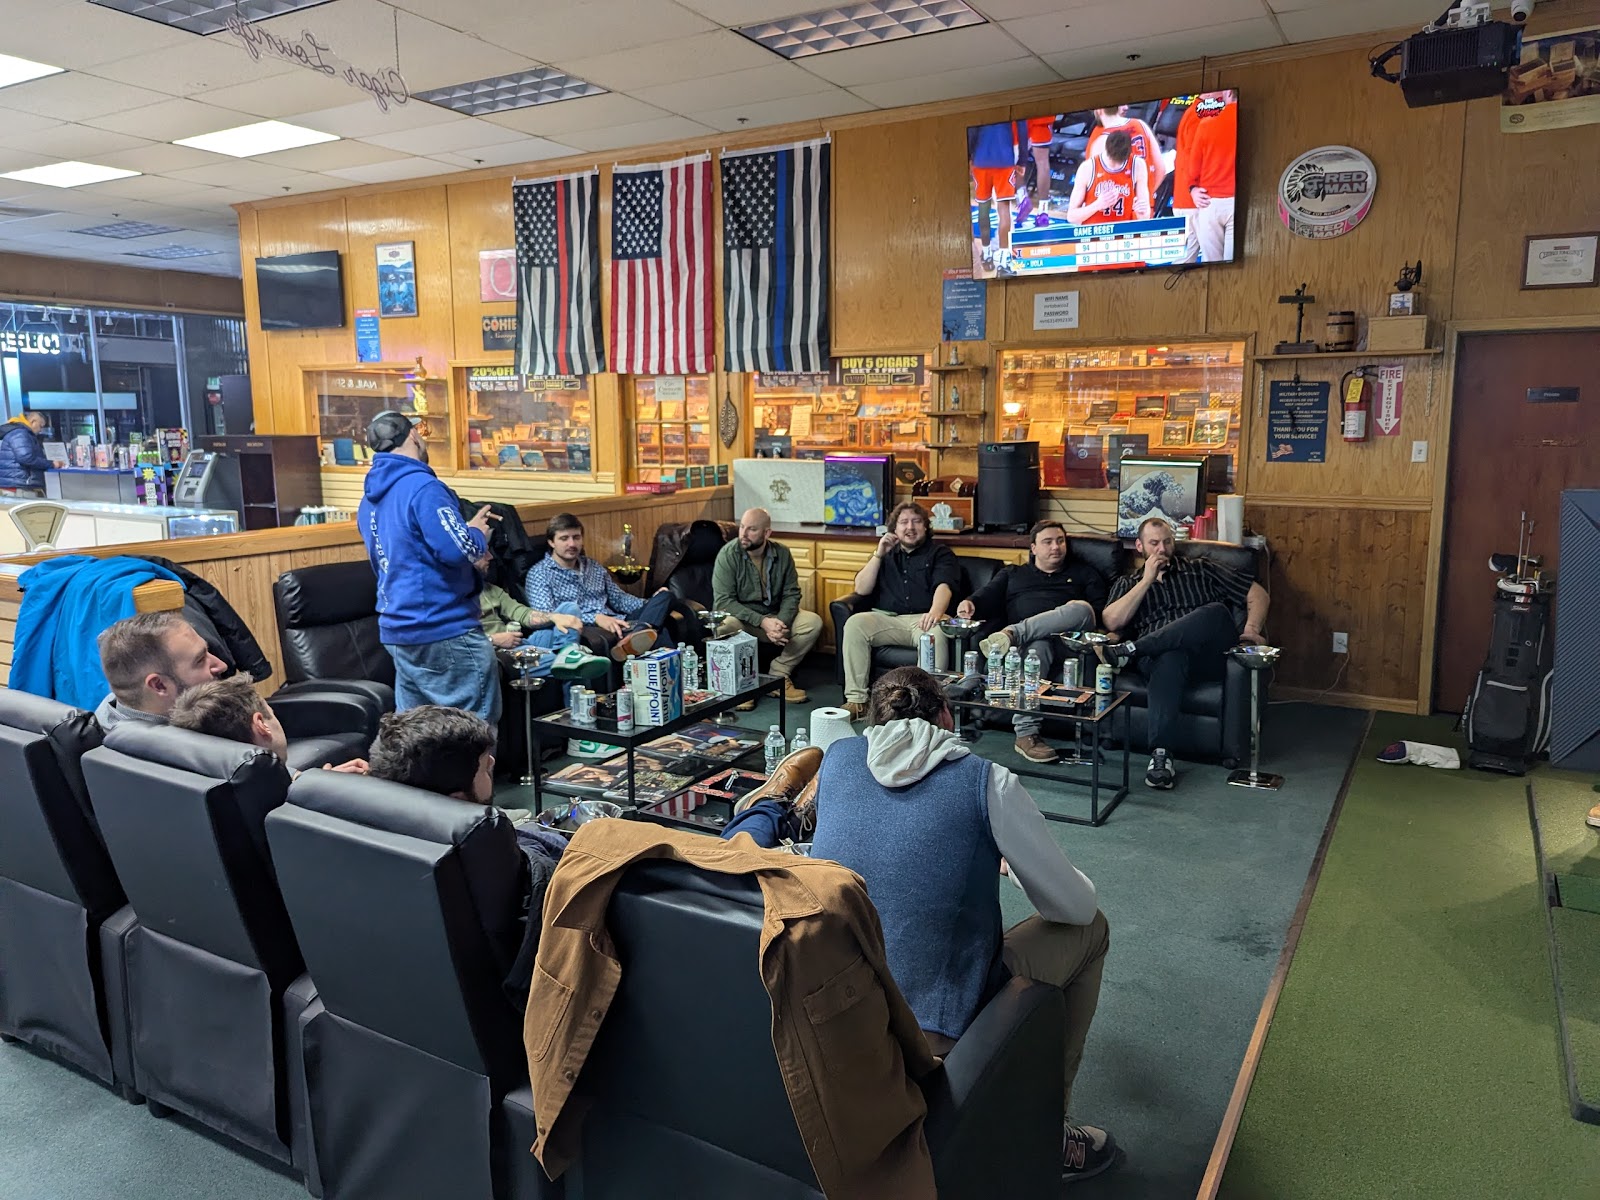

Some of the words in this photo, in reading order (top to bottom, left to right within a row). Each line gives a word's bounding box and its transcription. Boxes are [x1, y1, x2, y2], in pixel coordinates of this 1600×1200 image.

[1324, 171, 1368, 183] RED
[1324, 182, 1367, 194] MAN
[1073, 226, 1092, 237] GAME
[1093, 224, 1115, 235] RESET
[1313, 221, 1345, 231] RED
[1313, 229, 1344, 238] MAN
[1082, 244, 1090, 252] 94
[842, 357, 864, 369] BUY
[866, 357, 874, 368] 5
[876, 356, 918, 368] CIGARS
[1380, 369, 1402, 380] FIRE
[1384, 379, 1393, 431] EXTINGUISHER
[370, 511, 384, 556] HAULING
[1064, 1140, 1085, 1168] N
